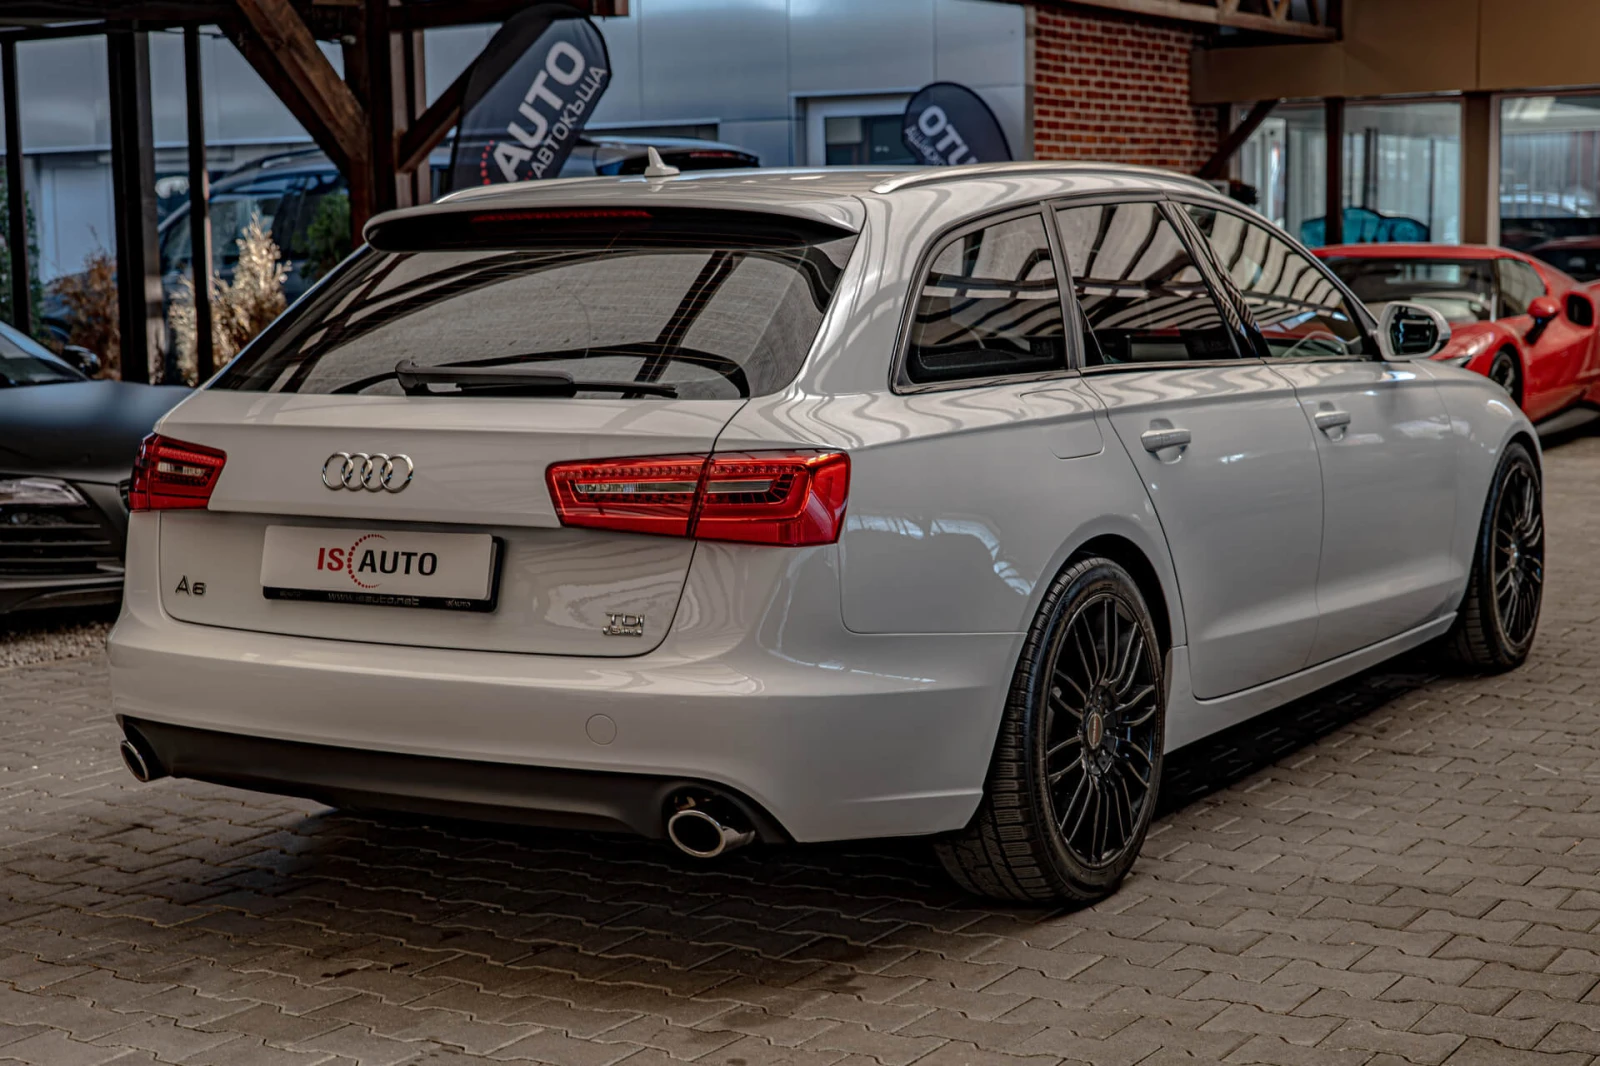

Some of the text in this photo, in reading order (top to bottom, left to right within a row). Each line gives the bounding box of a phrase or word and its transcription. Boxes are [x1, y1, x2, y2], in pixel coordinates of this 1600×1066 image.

[493, 41, 585, 182] AUTO
[531, 66, 607, 178] АВТОКЪЩА
[317, 547, 437, 576] IS AUTO
[175, 575, 206, 595] A6
[605, 613, 645, 627] TDI
